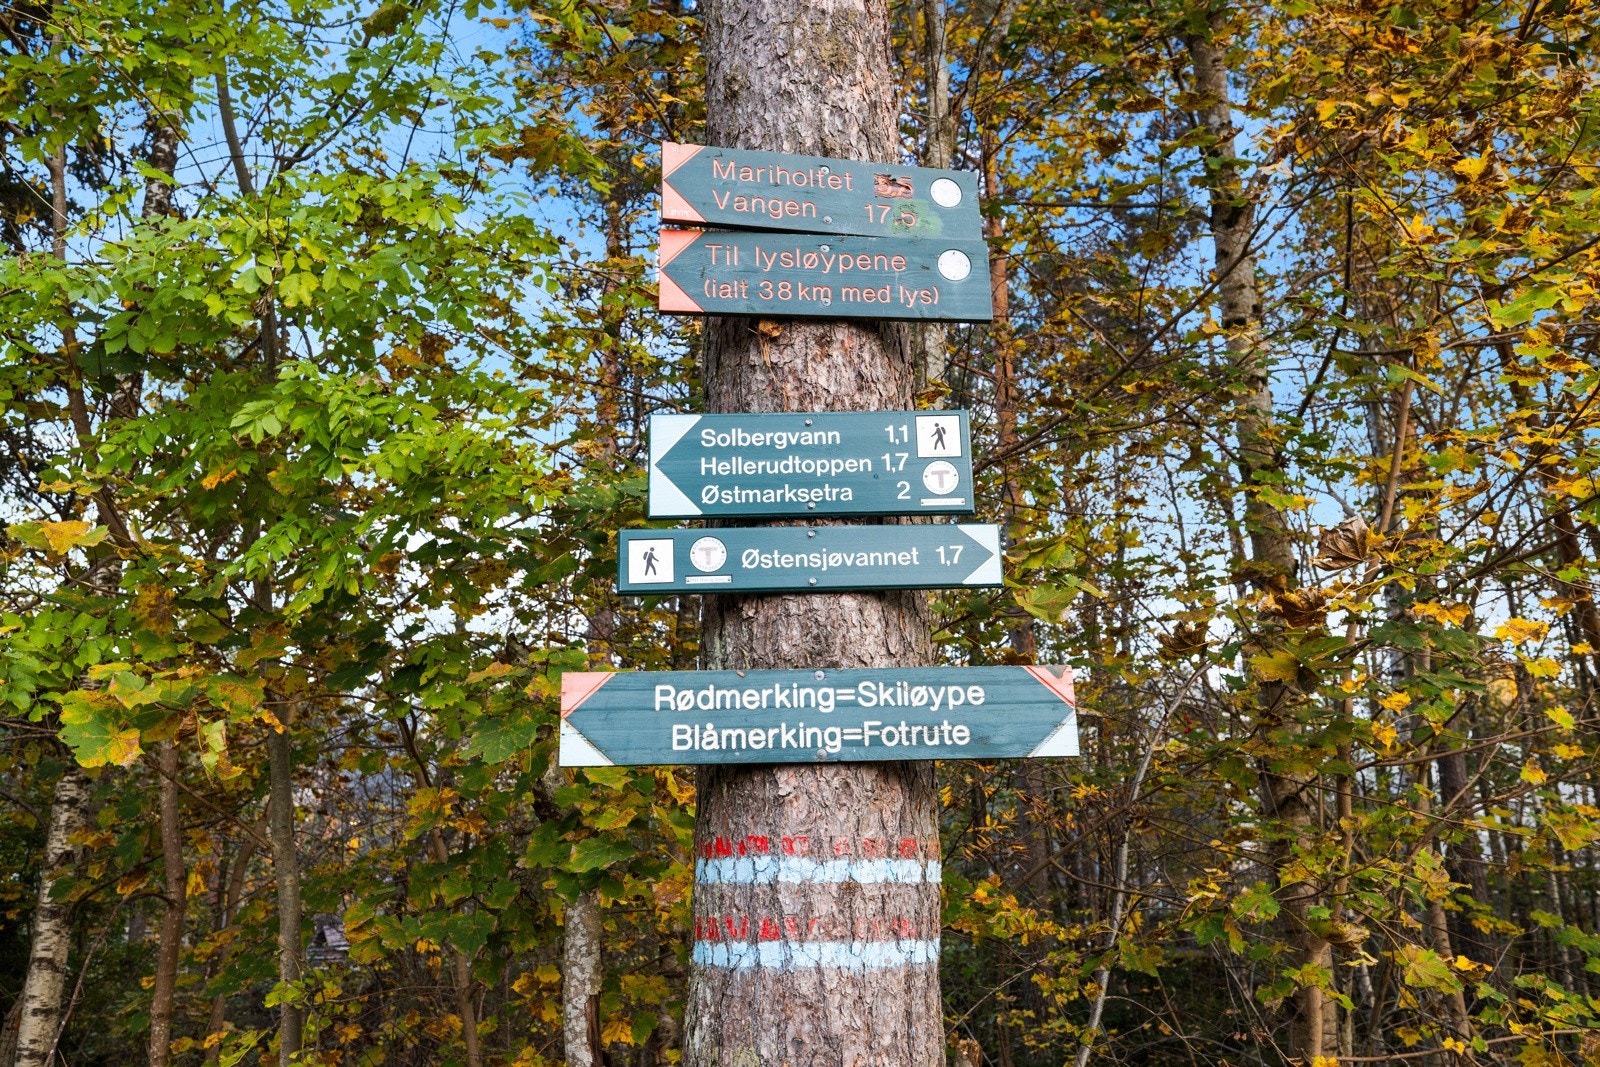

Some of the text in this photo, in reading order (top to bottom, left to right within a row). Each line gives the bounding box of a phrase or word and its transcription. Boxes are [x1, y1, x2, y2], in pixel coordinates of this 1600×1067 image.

[713, 158, 854, 191] Mariholtet
[712, 188, 817, 219] Vangen
[705, 244, 907, 274] Til lysløypene
[704, 278, 749, 299] (ialt
[842, 284, 891, 303] med
[900, 284, 940, 308] lys)
[700, 424, 909, 450] Solbergvann 1,1
[700, 456, 872, 476] Hellerudtoppen
[881, 452, 909, 473] 1,7
[701, 480, 911, 504] Østmarksetra 2
[741, 545, 964, 571] Østensjøvannet 1,7
[654, 681, 986, 713] Rødmerking=Skiløype
[671, 719, 971, 753] Blåmerking=Fotrute
